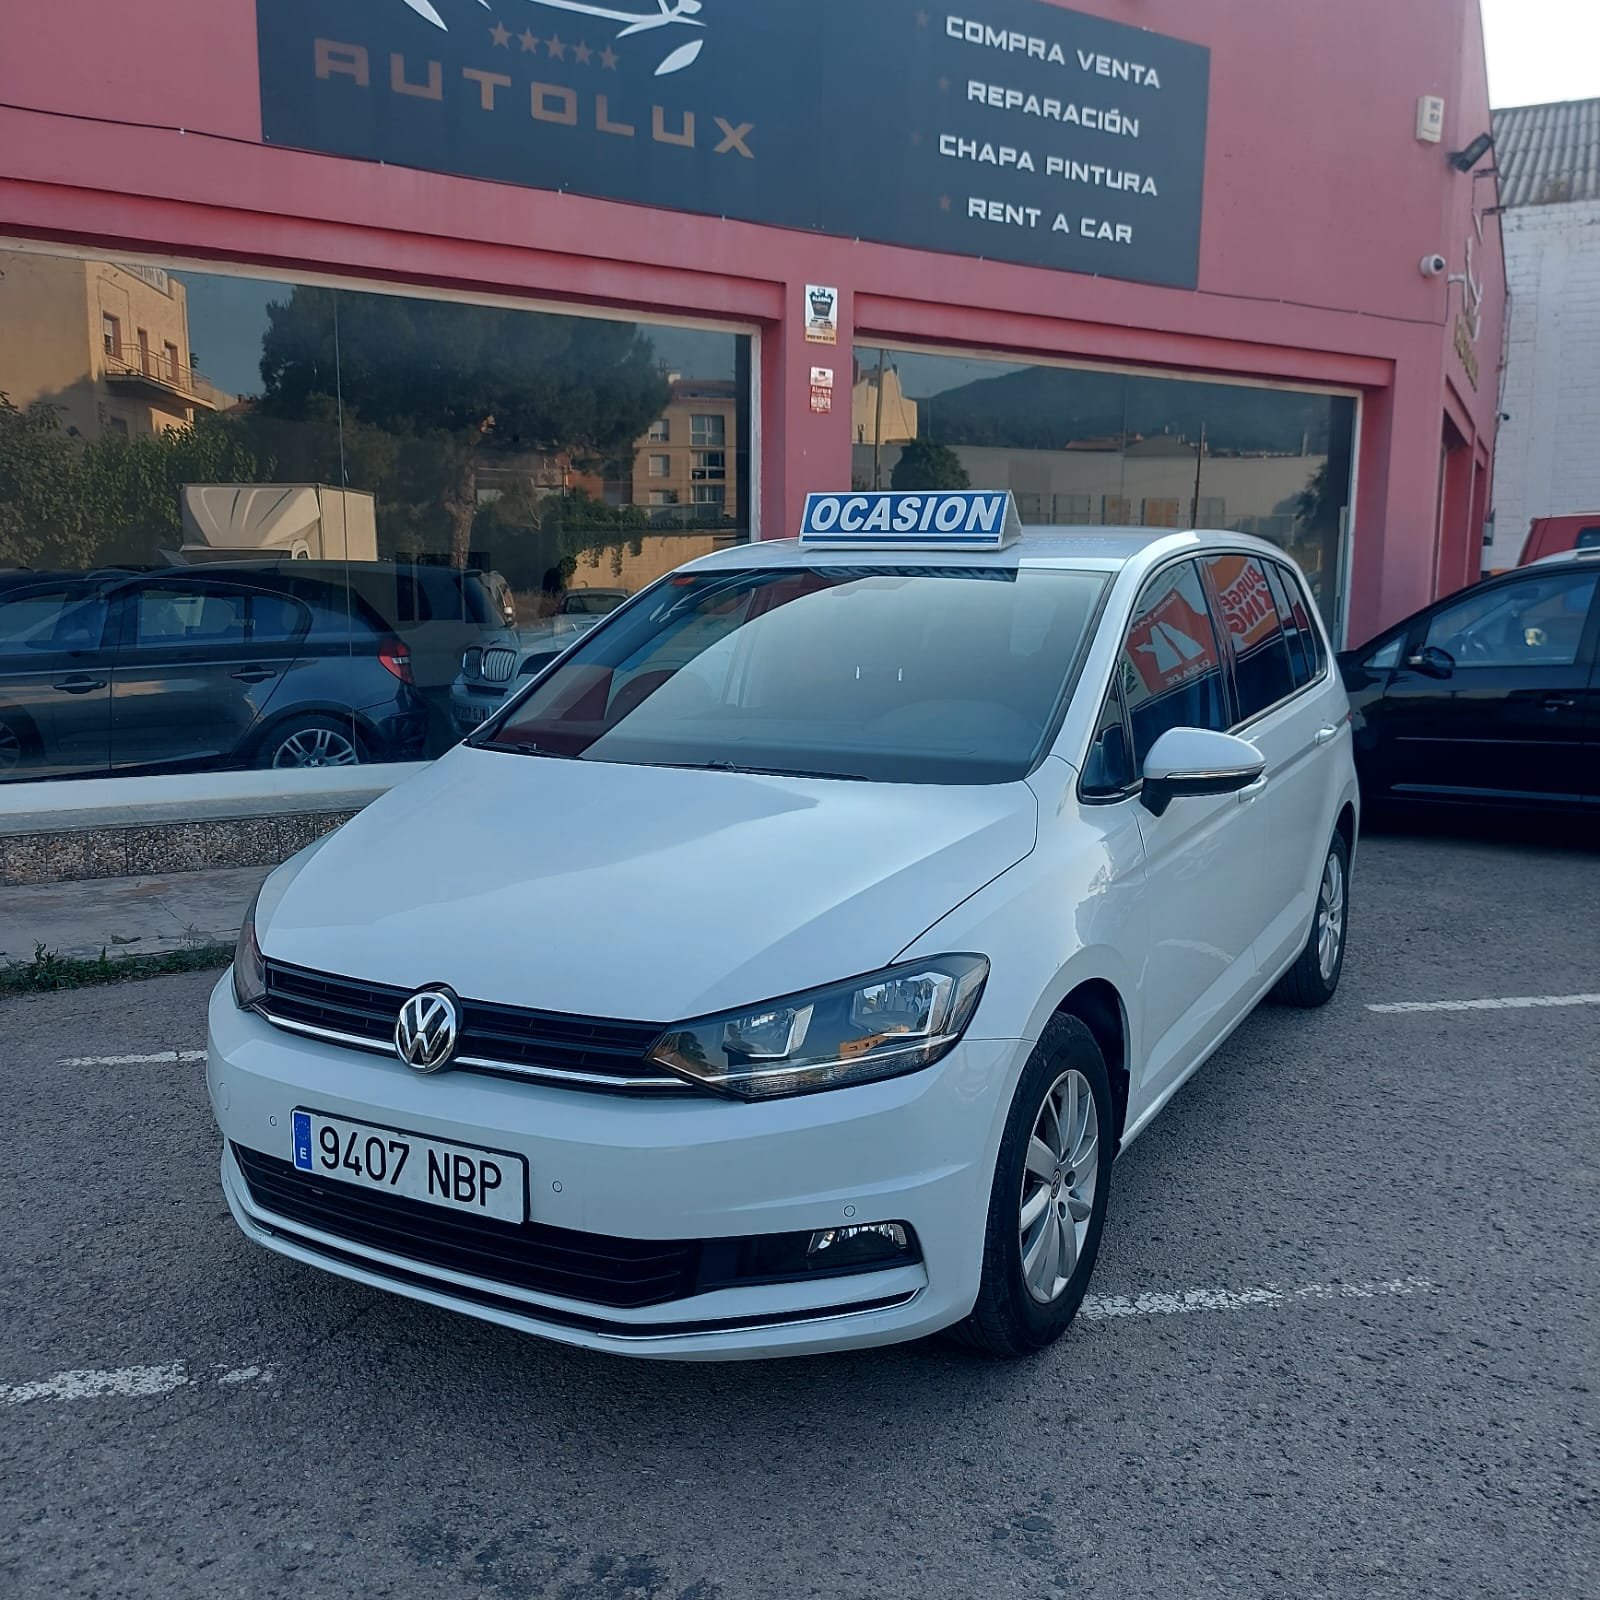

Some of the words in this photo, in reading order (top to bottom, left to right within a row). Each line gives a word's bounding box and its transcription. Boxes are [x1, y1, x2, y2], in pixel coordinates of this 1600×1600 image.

[946, 16, 1066, 65] COMPRA
[1077, 49, 1160, 88] VENTA
[314, 38, 755, 159] AUTOLUX
[968, 80, 1139, 137] REPARACIÓN
[939, 134, 1035, 172] CHAPA
[1046, 156, 1158, 196] PINTURA
[968, 197, 1041, 228] RENT
[1052, 213, 1070, 233] A
[1080, 217, 1132, 244] CAR
[810, 496, 1002, 532] OCASION
[299, 1147, 307, 1160] E
[319, 1126, 410, 1186] 9407
[428, 1149, 502, 1207] NBP
